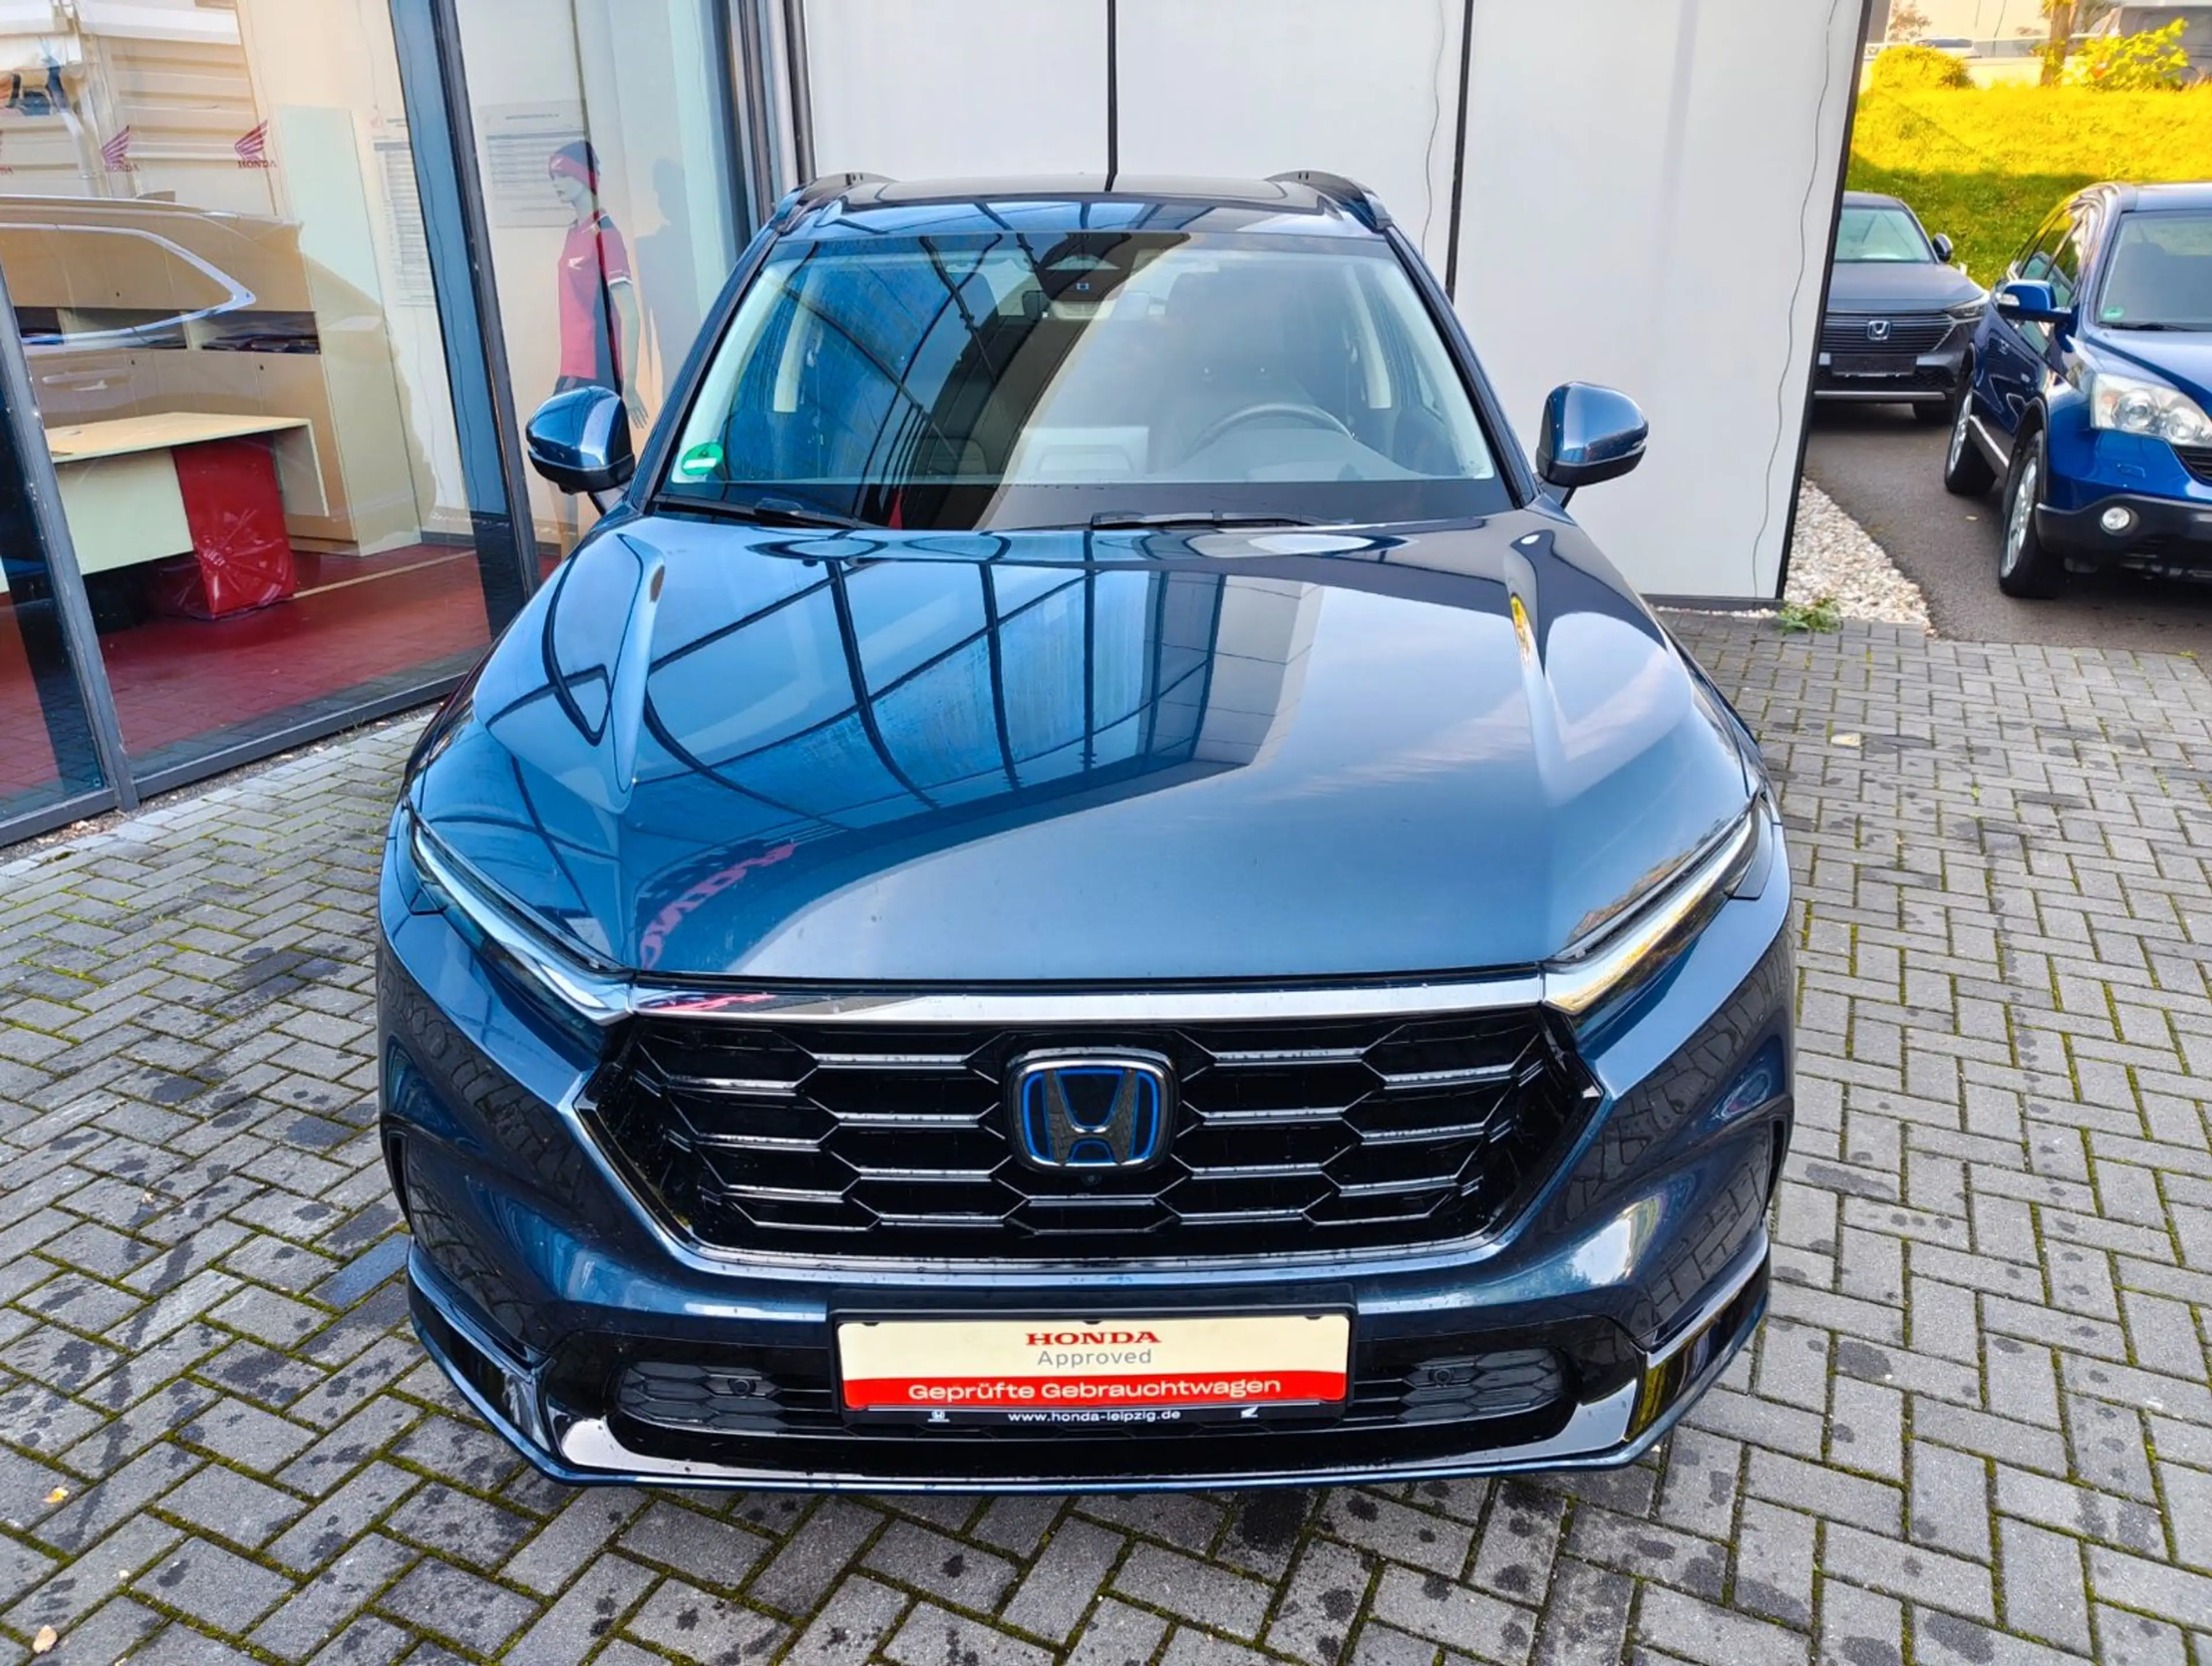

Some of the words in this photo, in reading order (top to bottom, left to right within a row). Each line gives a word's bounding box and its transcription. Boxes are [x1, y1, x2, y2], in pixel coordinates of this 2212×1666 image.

[237, 160, 278, 168] HONDA
[1025, 1331, 1162, 1346] HONDA
[1037, 1348, 1152, 1369] Approved
[908, 1383, 1035, 1403] Geprüfte
[1041, 1378, 1281, 1399] Gebrauchtwagen
[1007, 1409, 1182, 1423] www.honda-leipzig.de
